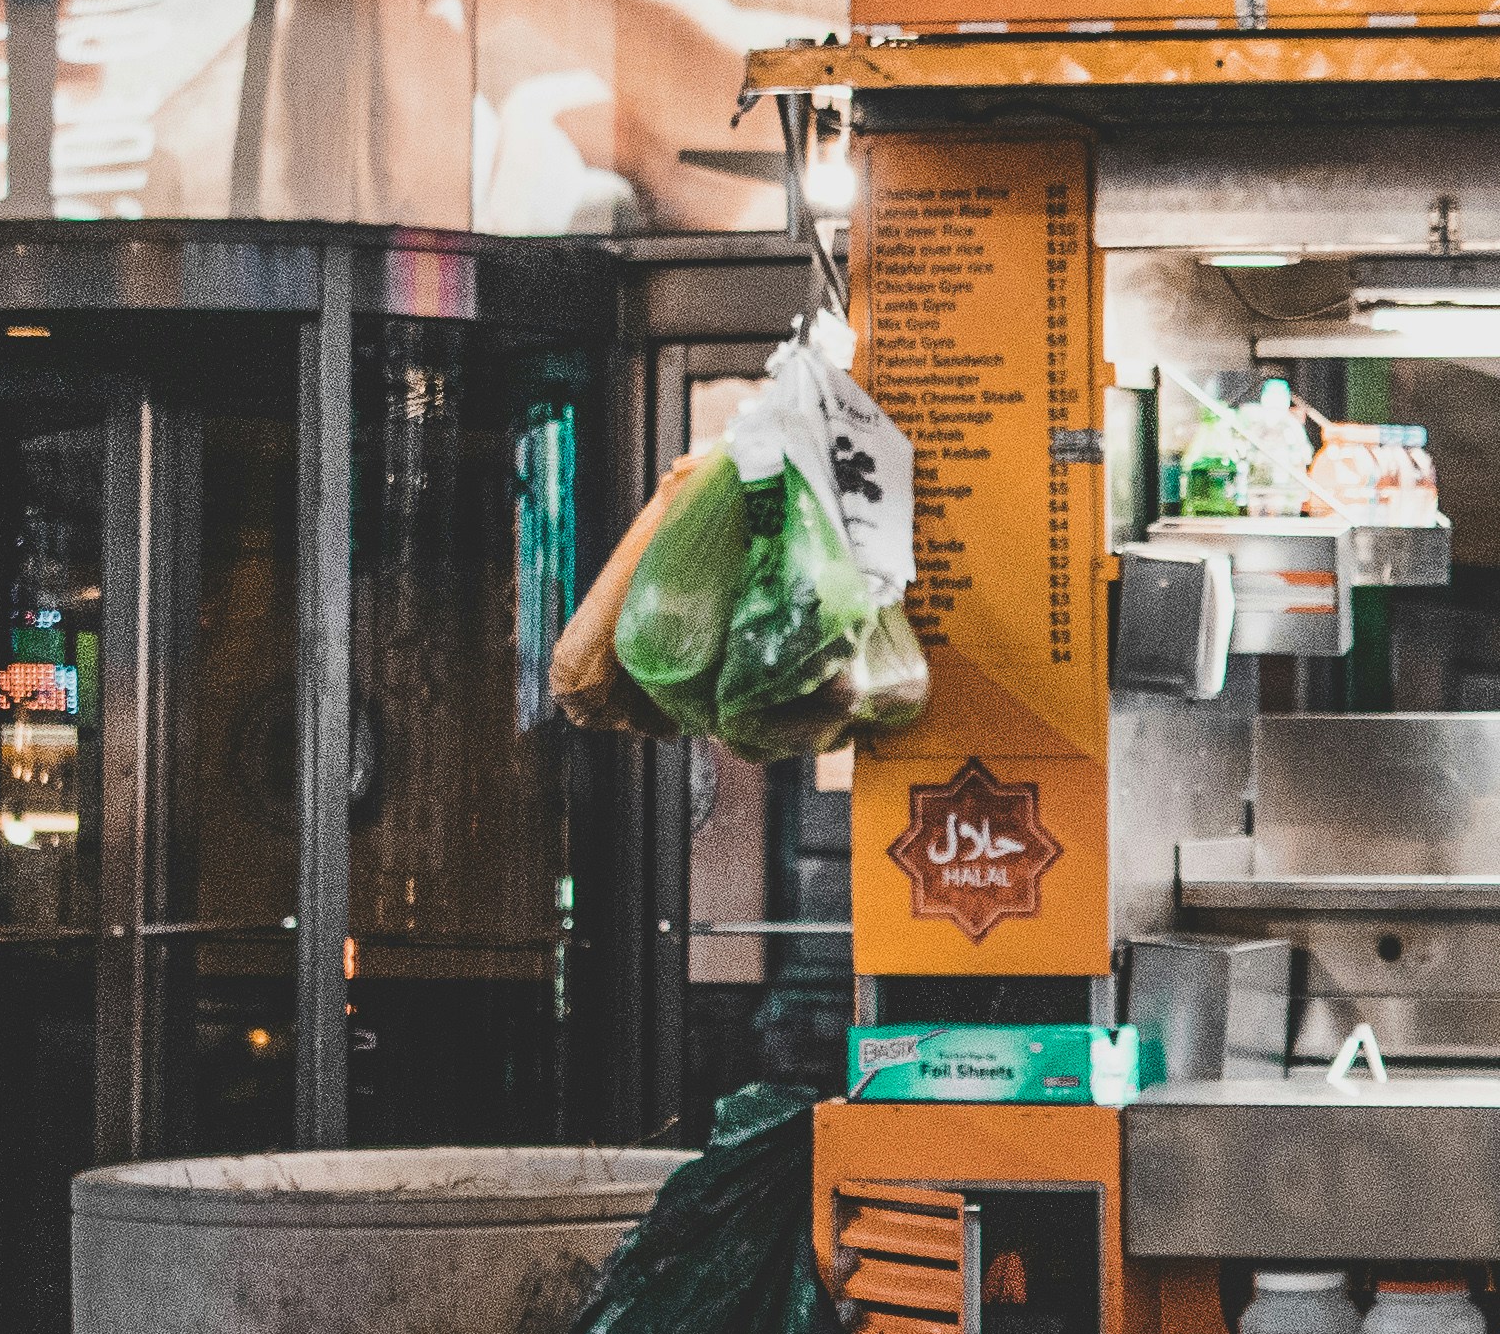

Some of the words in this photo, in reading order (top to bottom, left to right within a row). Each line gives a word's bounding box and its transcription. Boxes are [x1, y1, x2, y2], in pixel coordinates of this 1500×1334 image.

[876, 373, 980, 388] Cheeseburger
[921, 391, 976, 404] Cheese
[927, 813, 1025, 865] حلال
[941, 866, 1011, 888] HALAL
